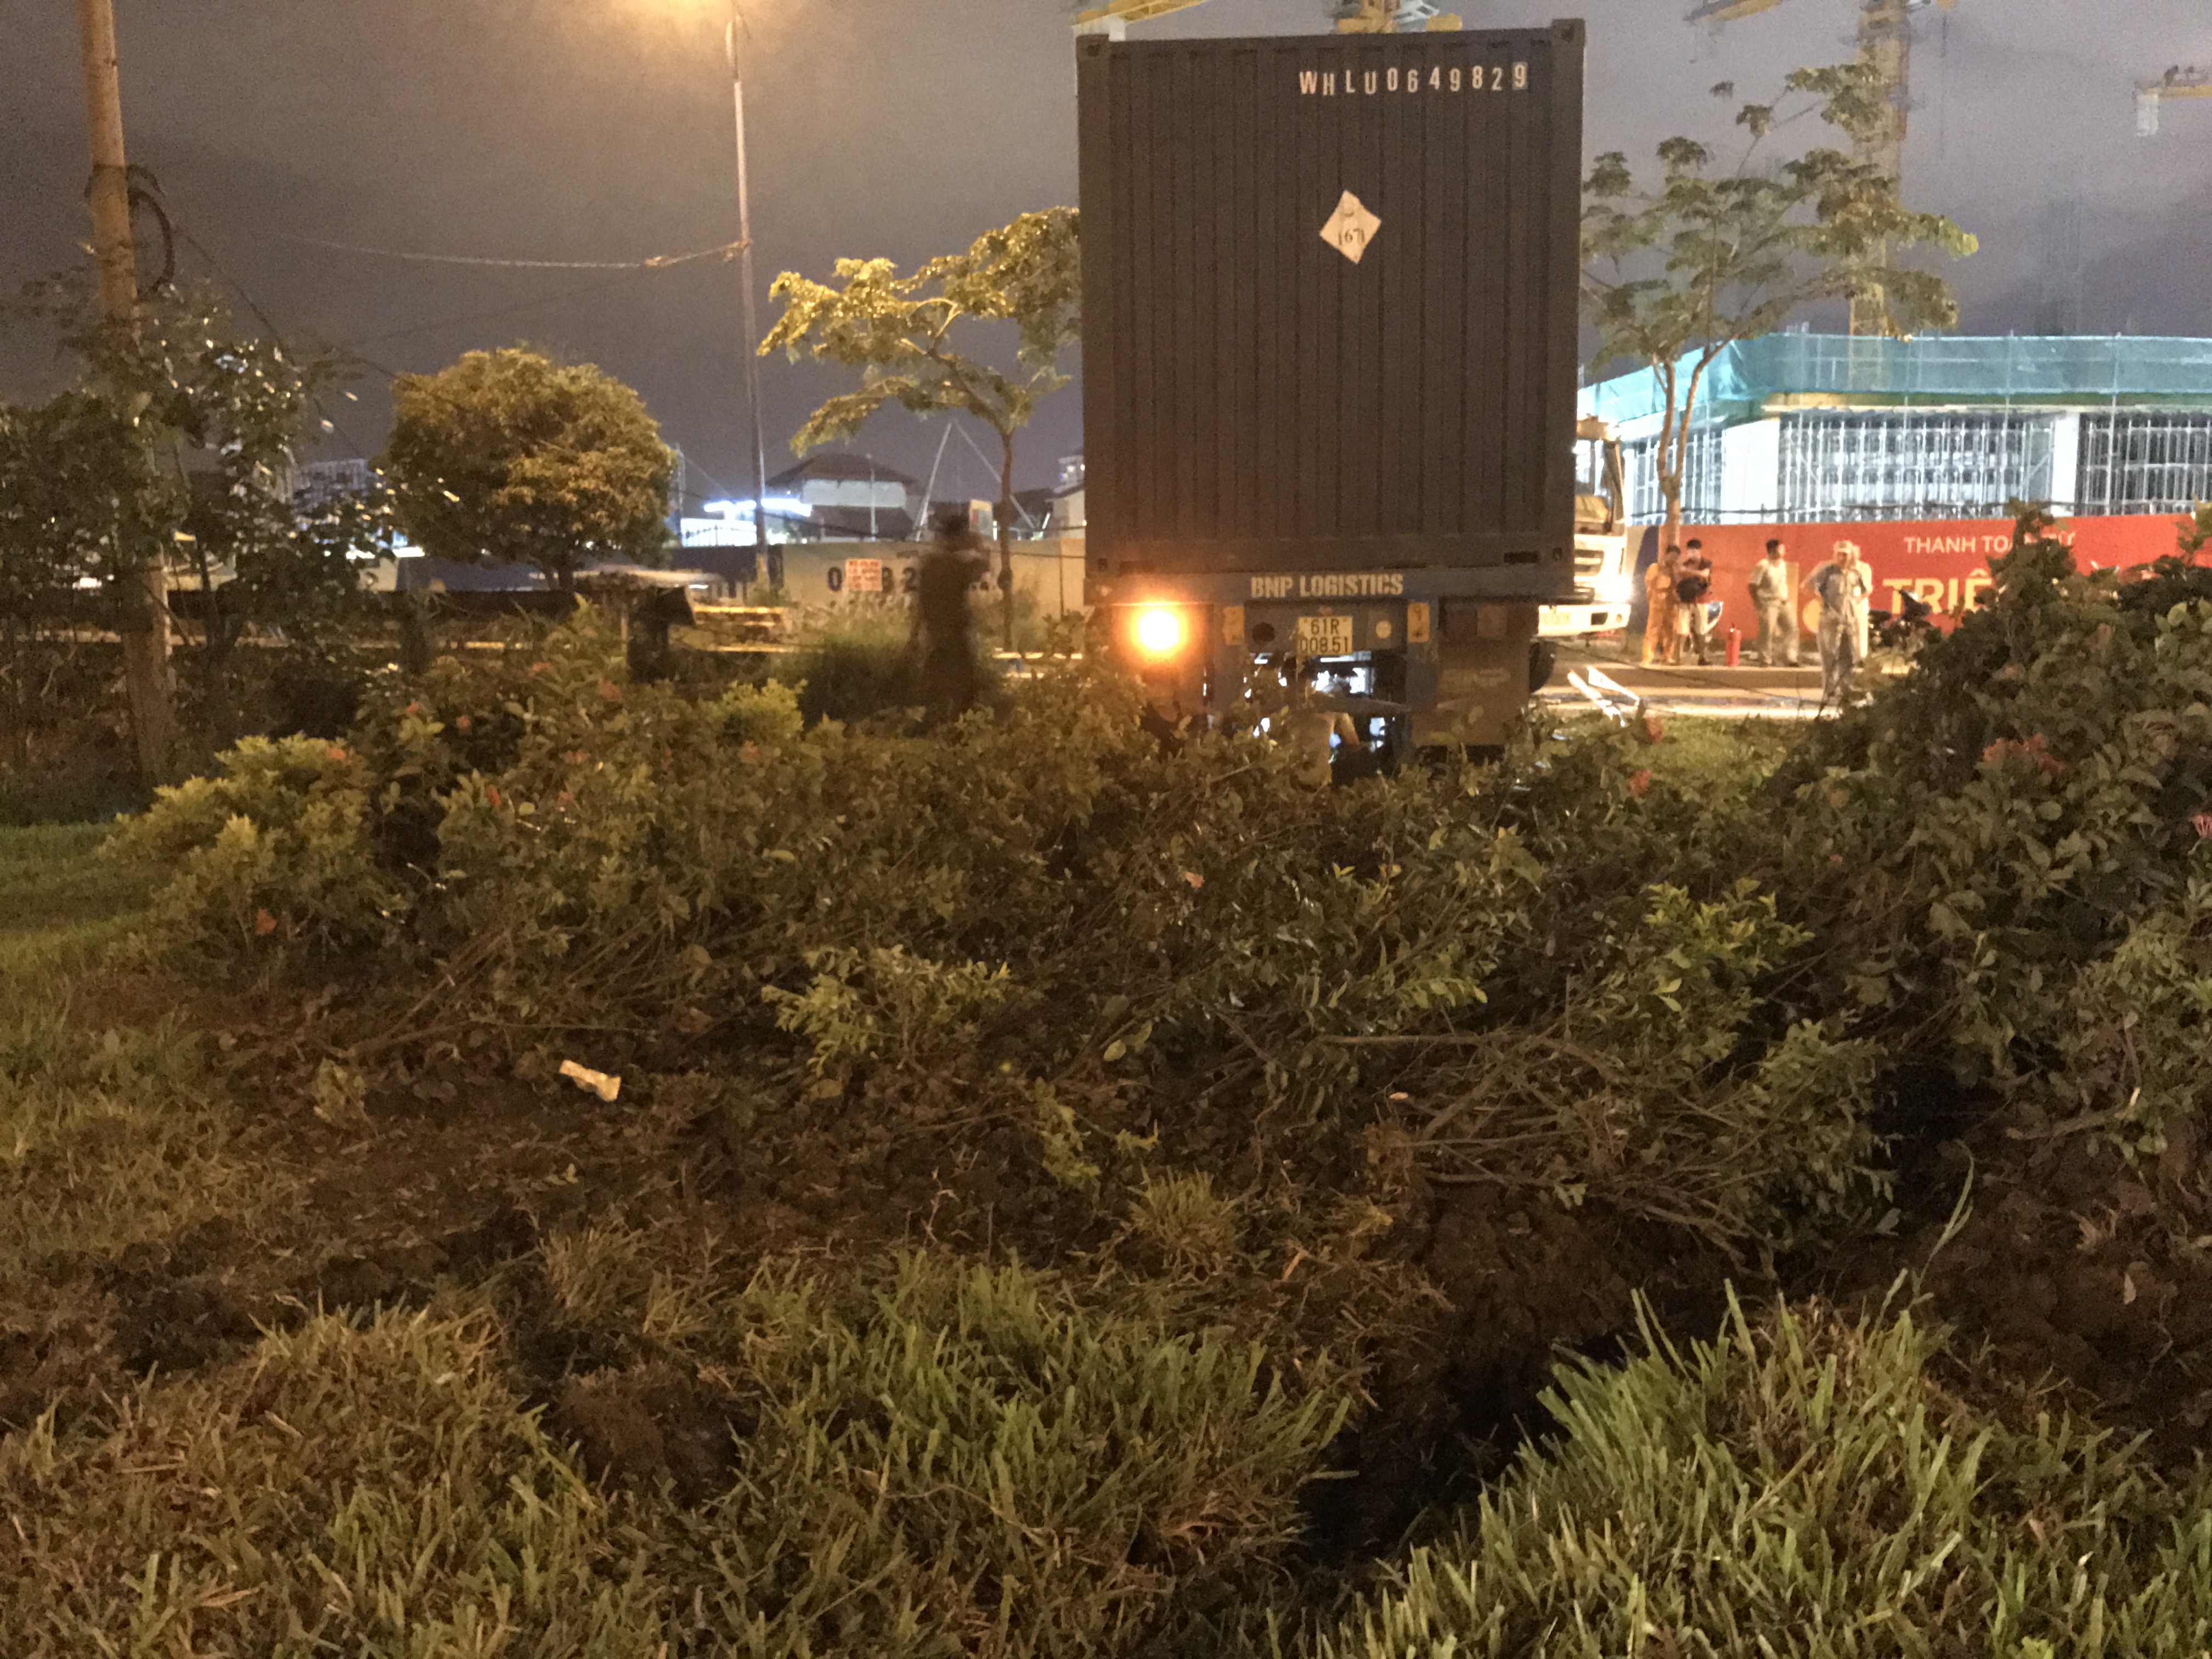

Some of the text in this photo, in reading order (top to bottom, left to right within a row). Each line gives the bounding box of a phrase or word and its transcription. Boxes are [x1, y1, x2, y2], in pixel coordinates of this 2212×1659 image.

[1904, 536, 1976, 554] THANH
[1251, 574, 1403, 598] BNP LOGISTICS
[1311, 619, 1339, 635] 61R
